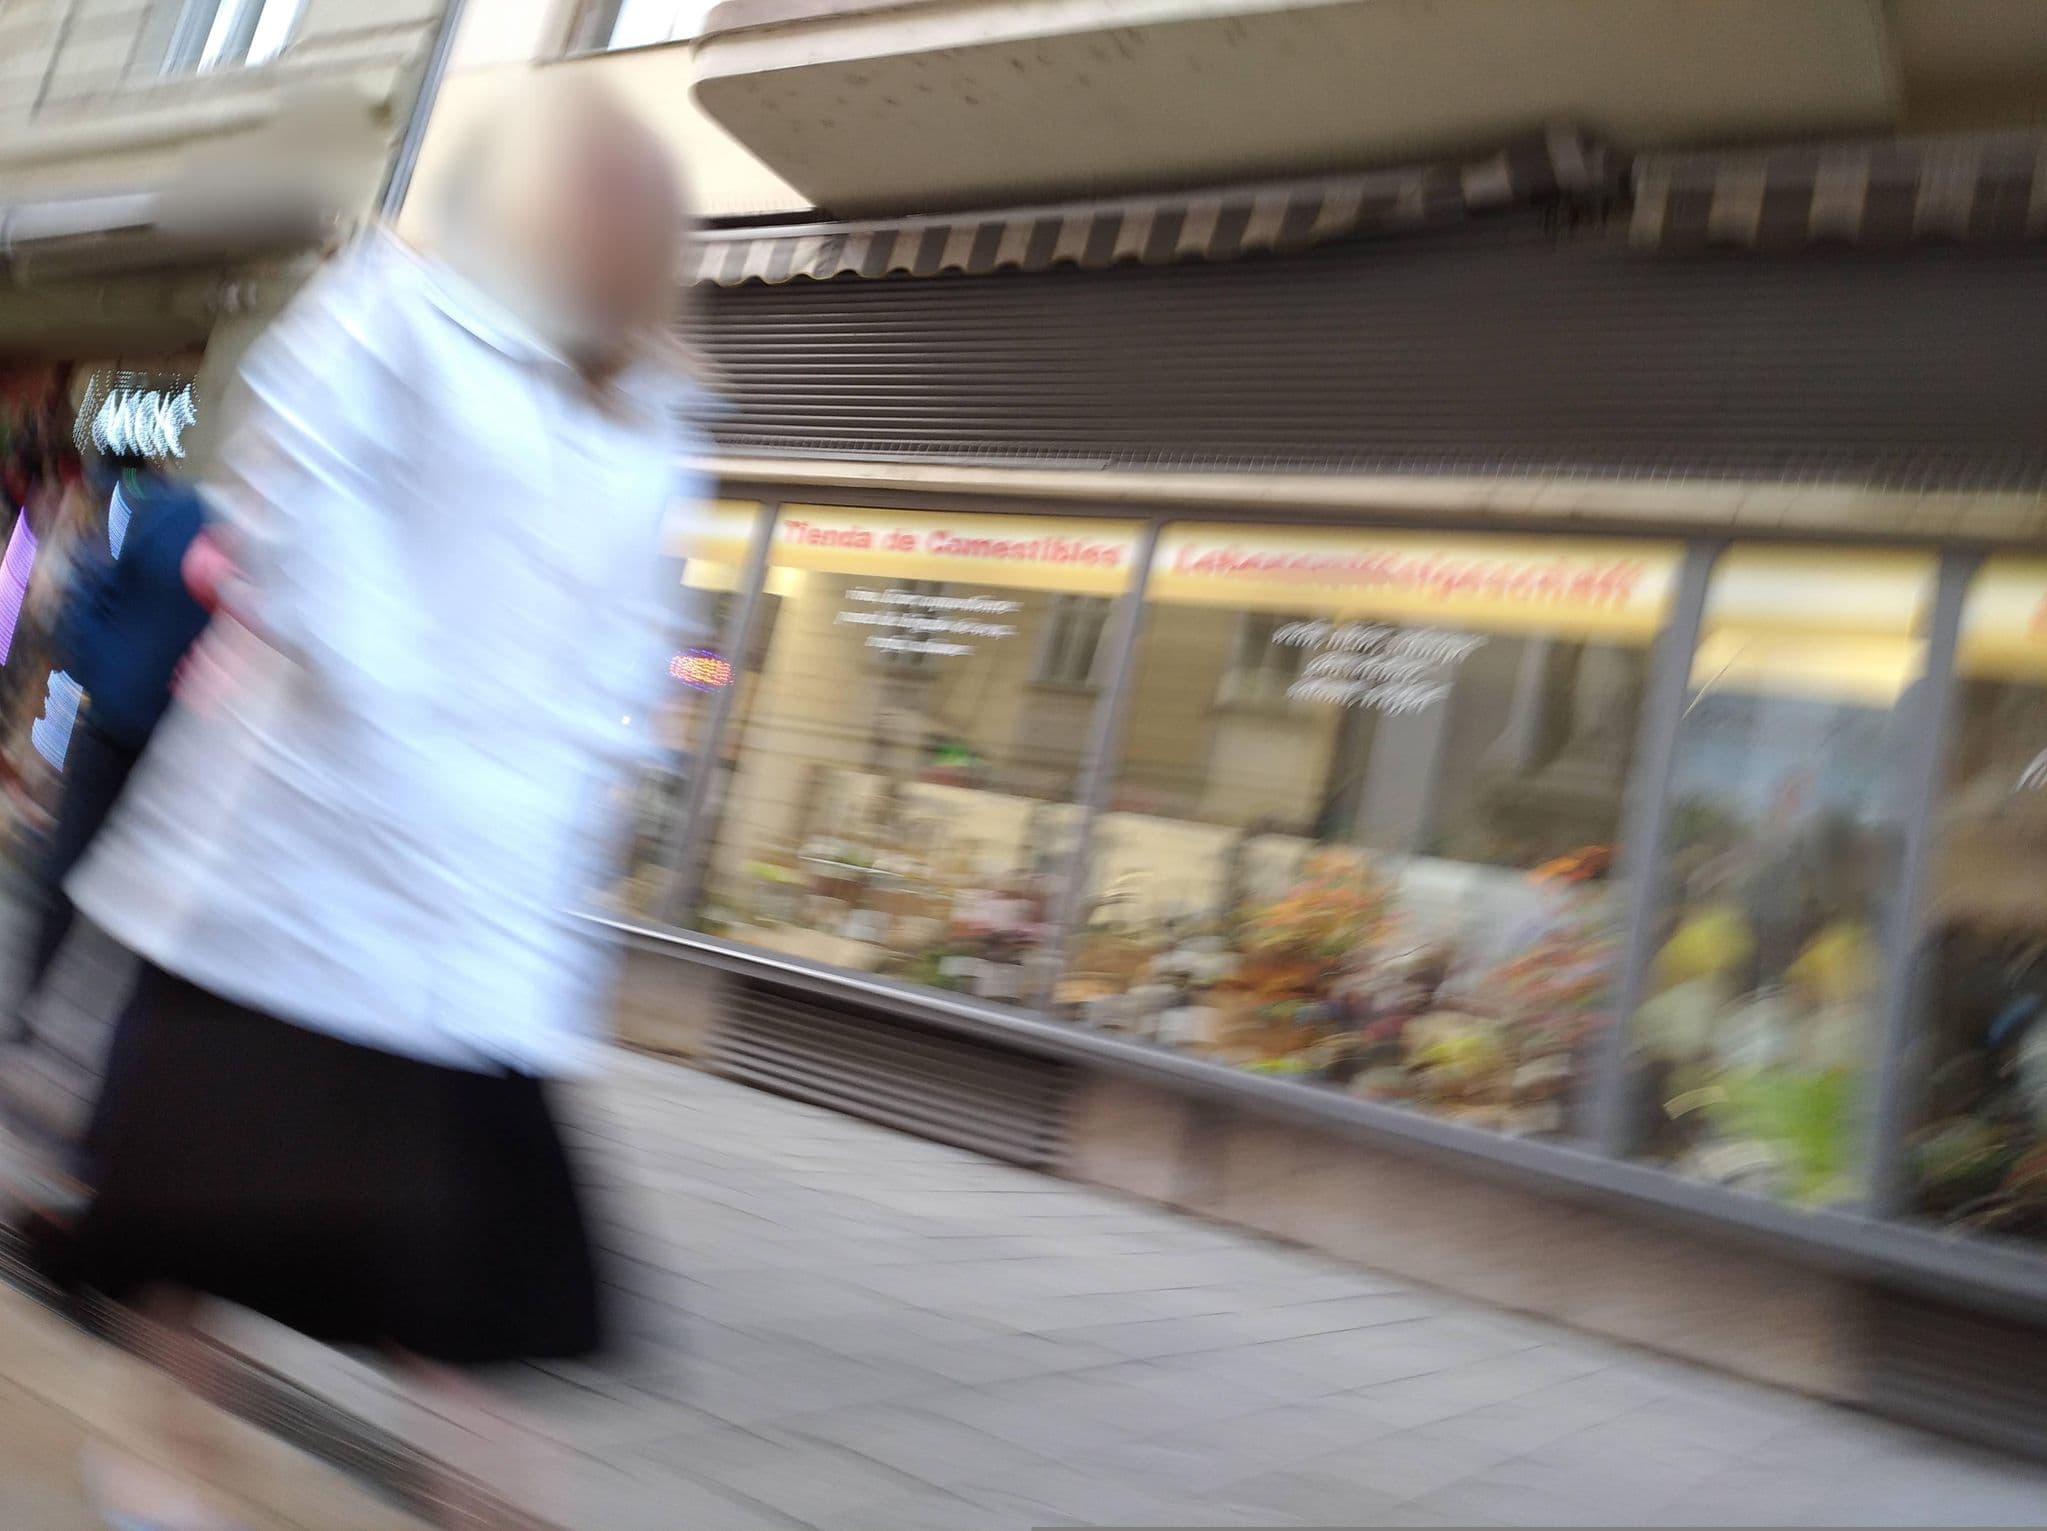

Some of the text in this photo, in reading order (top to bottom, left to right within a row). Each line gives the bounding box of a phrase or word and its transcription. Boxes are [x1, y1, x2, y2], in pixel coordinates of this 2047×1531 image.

[783, 518, 1122, 567] Tienda de Comestibles
